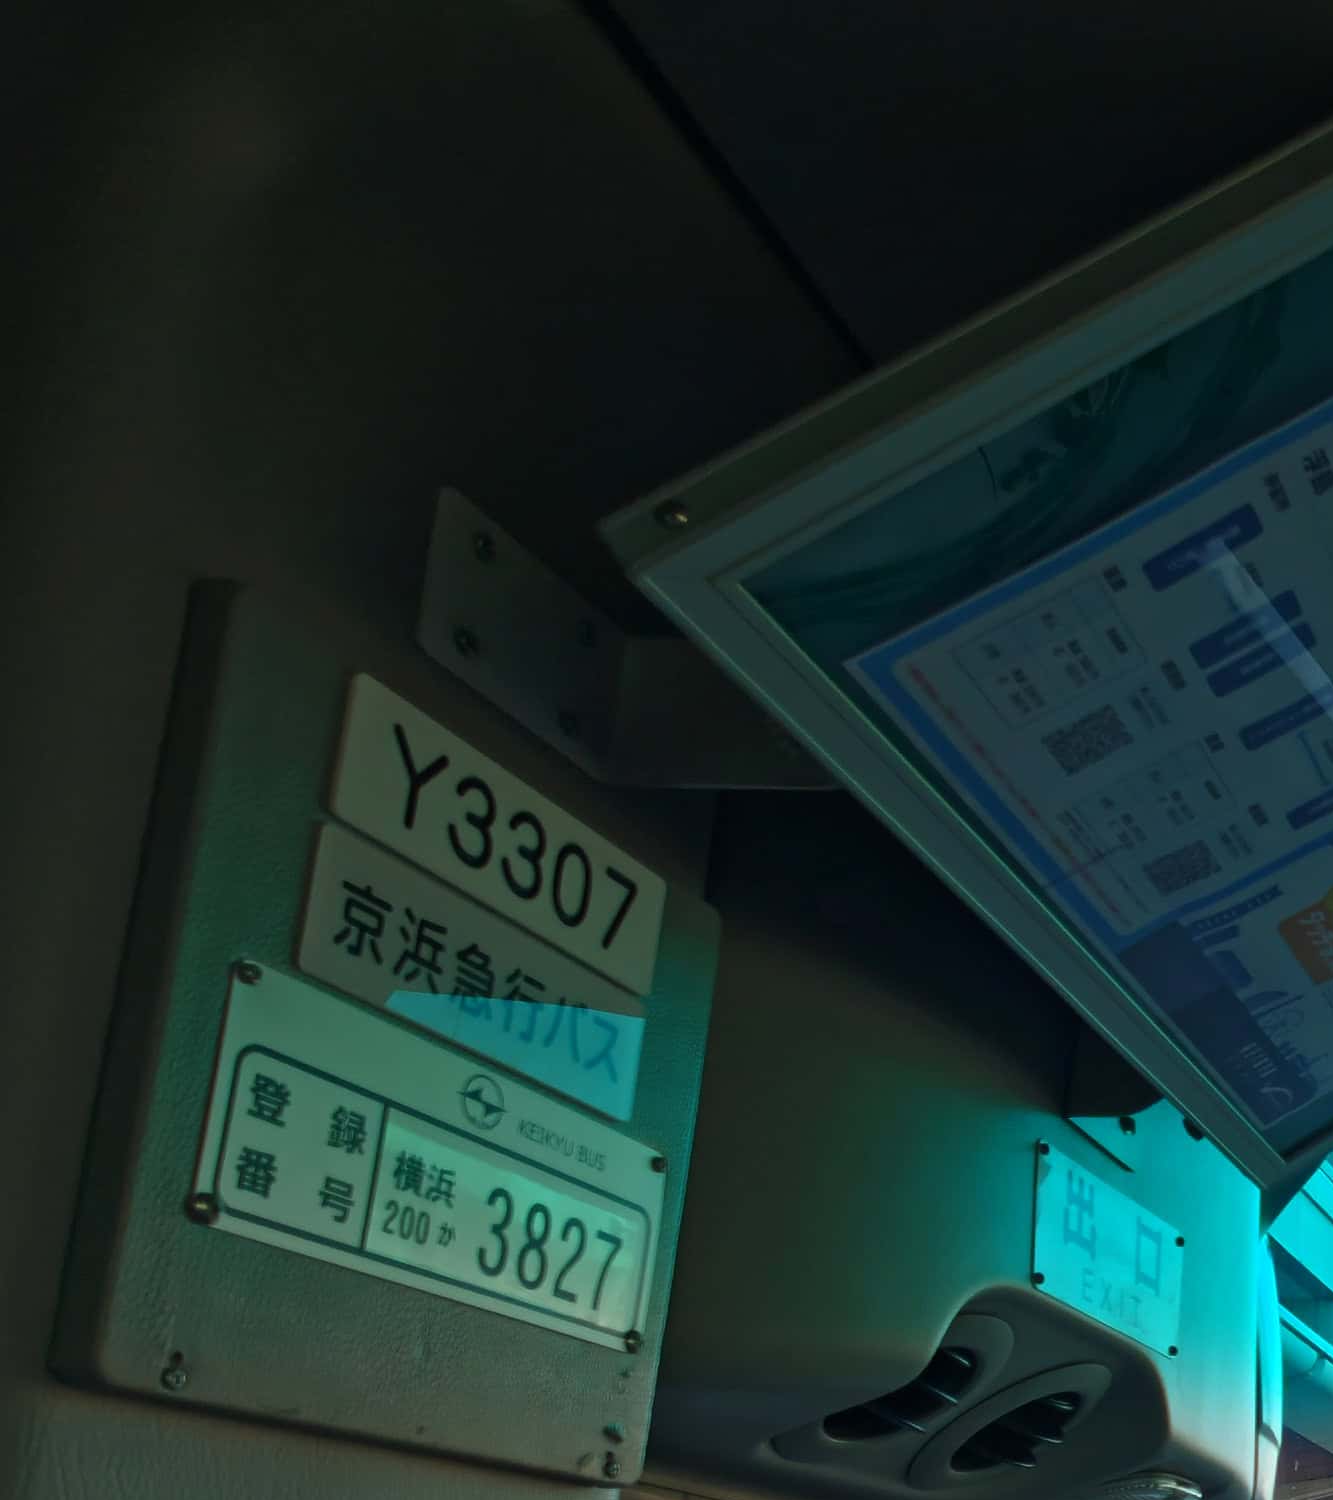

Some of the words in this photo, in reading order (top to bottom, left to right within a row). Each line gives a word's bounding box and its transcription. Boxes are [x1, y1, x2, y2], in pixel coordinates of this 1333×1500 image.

[393, 723, 638, 950] Y3307
[333, 880, 618, 1084] 京浜急行バス
[248, 1073, 367, 1156] 登録
[518, 1119, 574, 1161] KEIKYU
[576, 1142, 608, 1172] BUS
[235, 1146, 355, 1224] 番号
[392, 1151, 457, 1209] 横浜
[382, 1201, 430, 1247] 200
[477, 1187, 623, 1312] 3827
[1063, 1169, 1162, 1297] 出口
